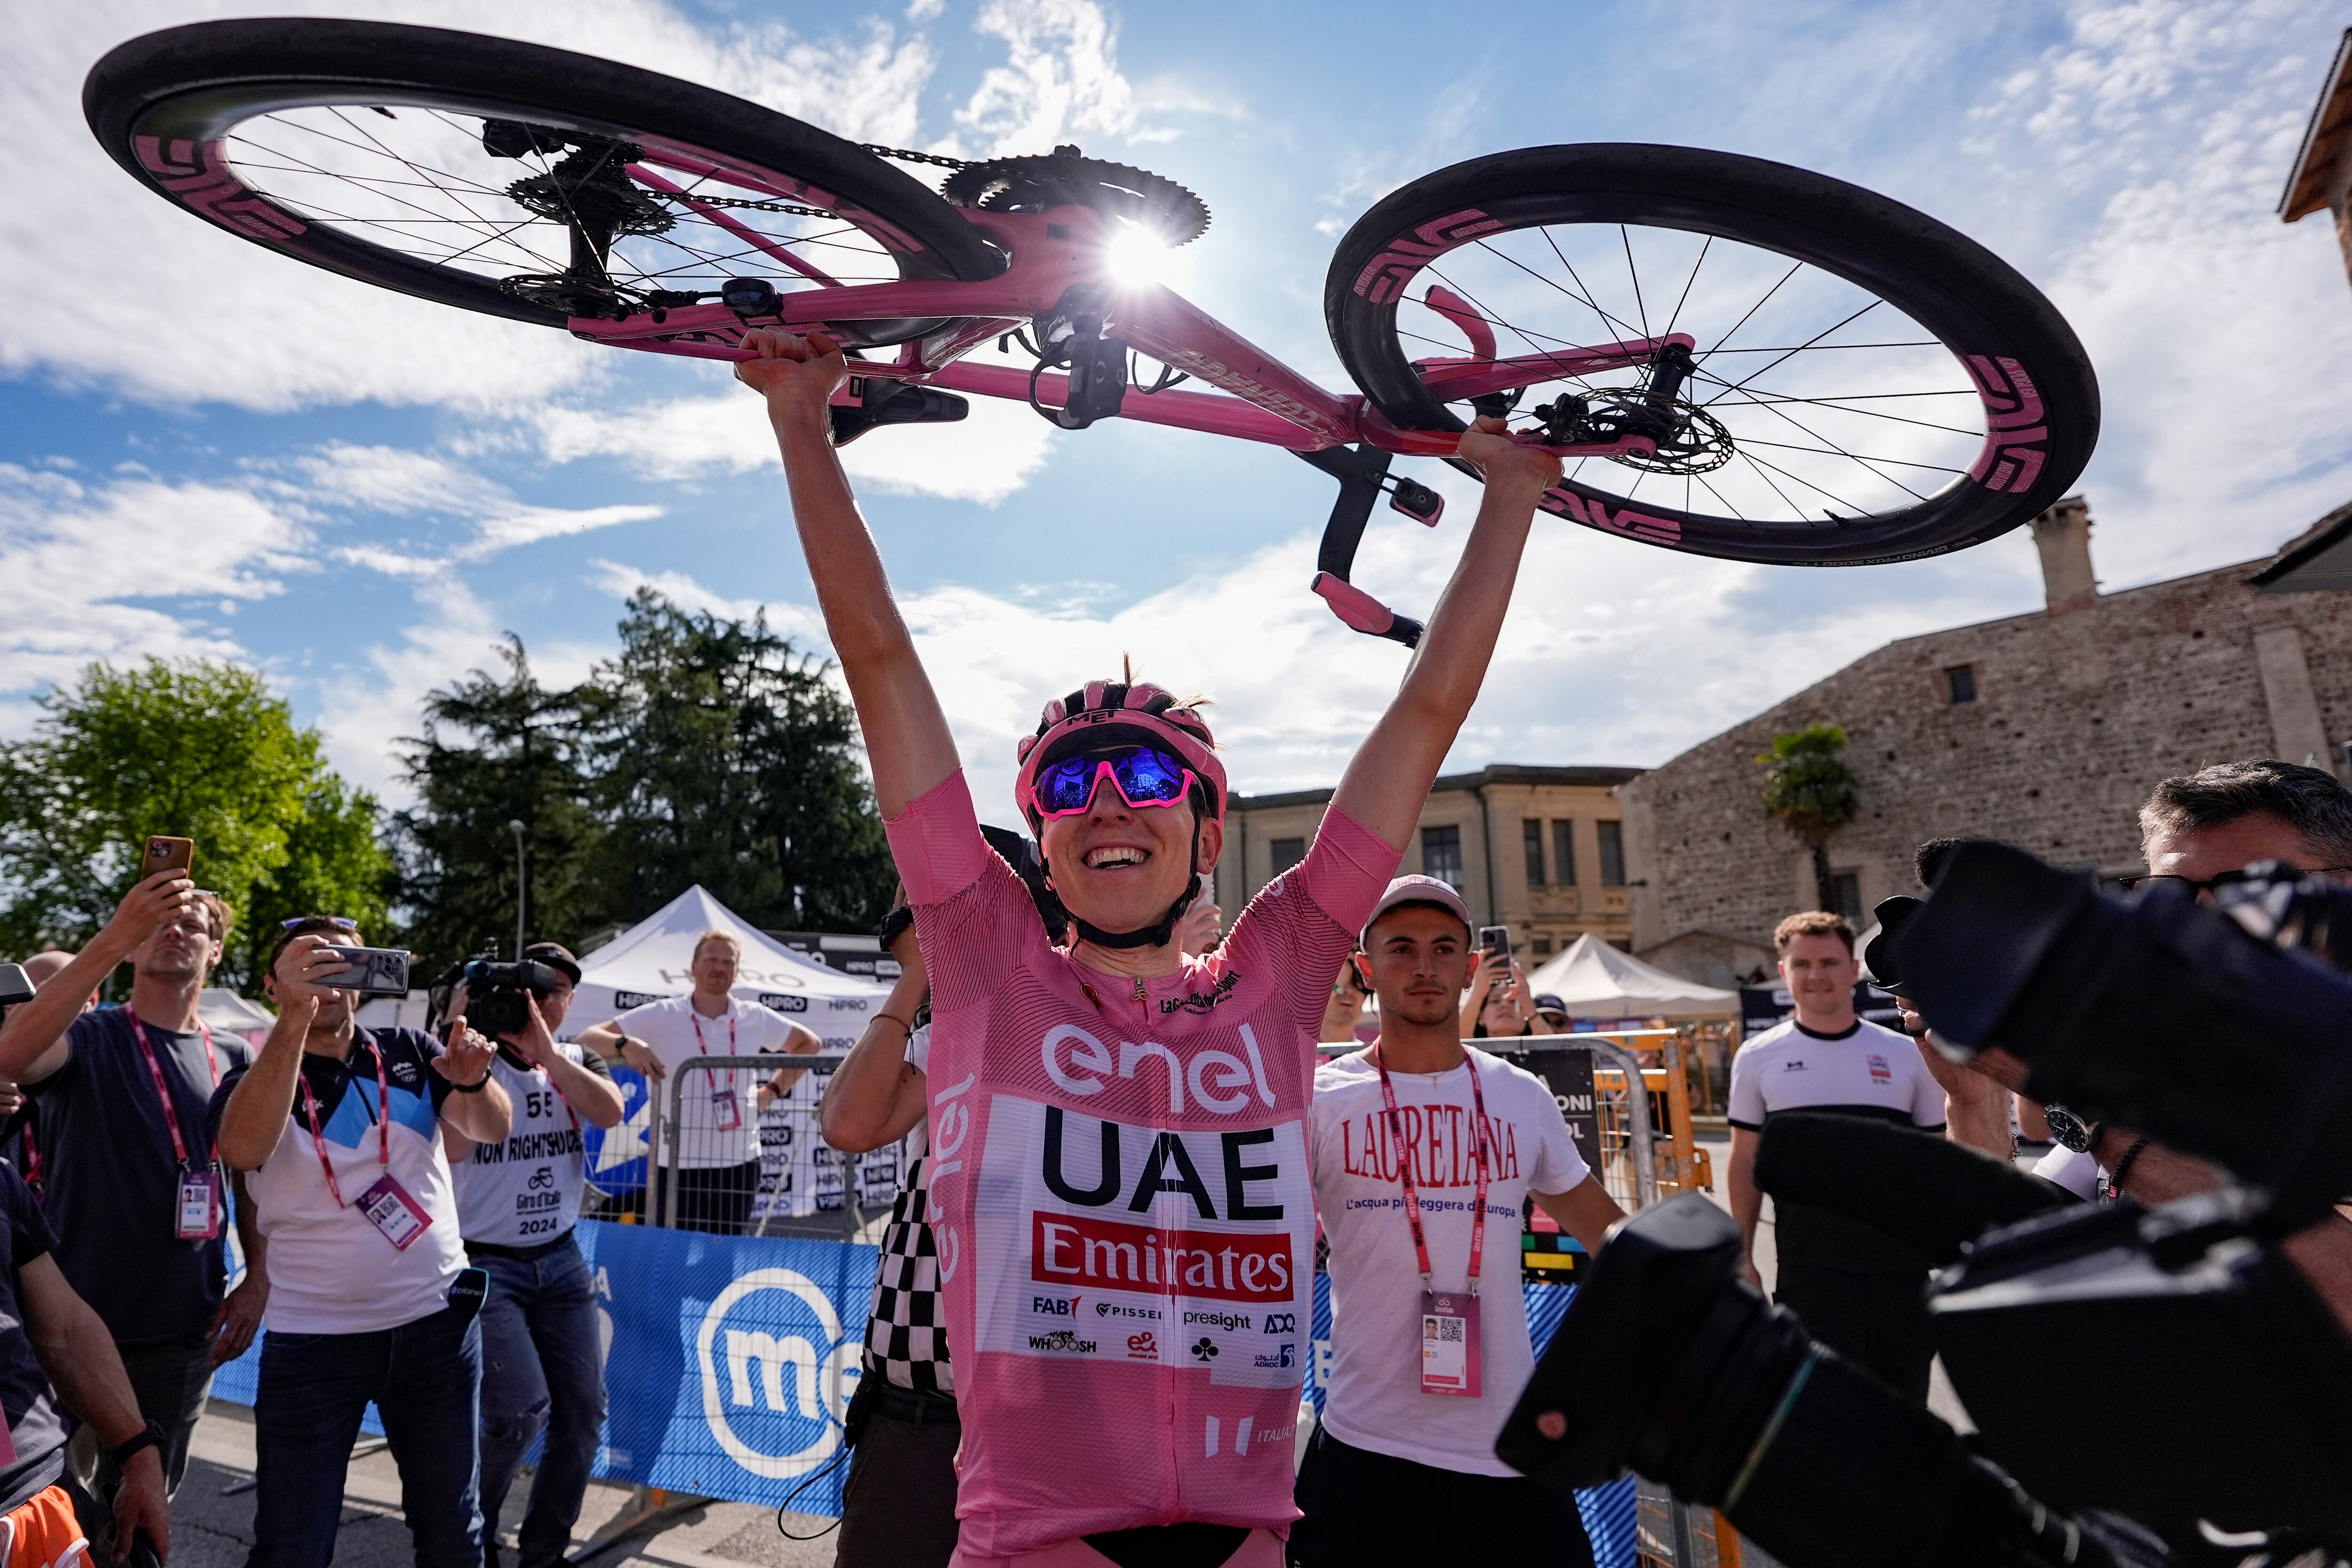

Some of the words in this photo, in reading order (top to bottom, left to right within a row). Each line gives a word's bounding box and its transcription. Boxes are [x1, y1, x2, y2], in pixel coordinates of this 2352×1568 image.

[1477, 219, 1502, 231] ROSA
[1158, 346, 1319, 425] COLNAGO
[1866, 555, 1901, 565] PRIX
[1902, 545, 1948, 560] GRAND
[1067, 710, 1116, 726] MET
[934, 882, 977, 912] #GIRODITALIA
[1160, 999, 1172, 1013] La
[1041, 1024, 1276, 1114] enel
[473, 1141, 505, 1165] NON
[1342, 1104, 1519, 1188] LAURETANA
[1042, 1105, 1284, 1221] UAE
[929, 1072, 976, 1285] enel
[1347, 1197, 1389, 1210] L'acqua
[518, 1216, 557, 1234] 2024
[1041, 1221, 1288, 1293] Emirates
[1112, 1306, 1161, 1320] PISSEI
[1184, 1312, 1251, 1332] presight
[1263, 1313, 1296, 1334] ADQ
[1028, 1336, 1097, 1353] WHOOSH
